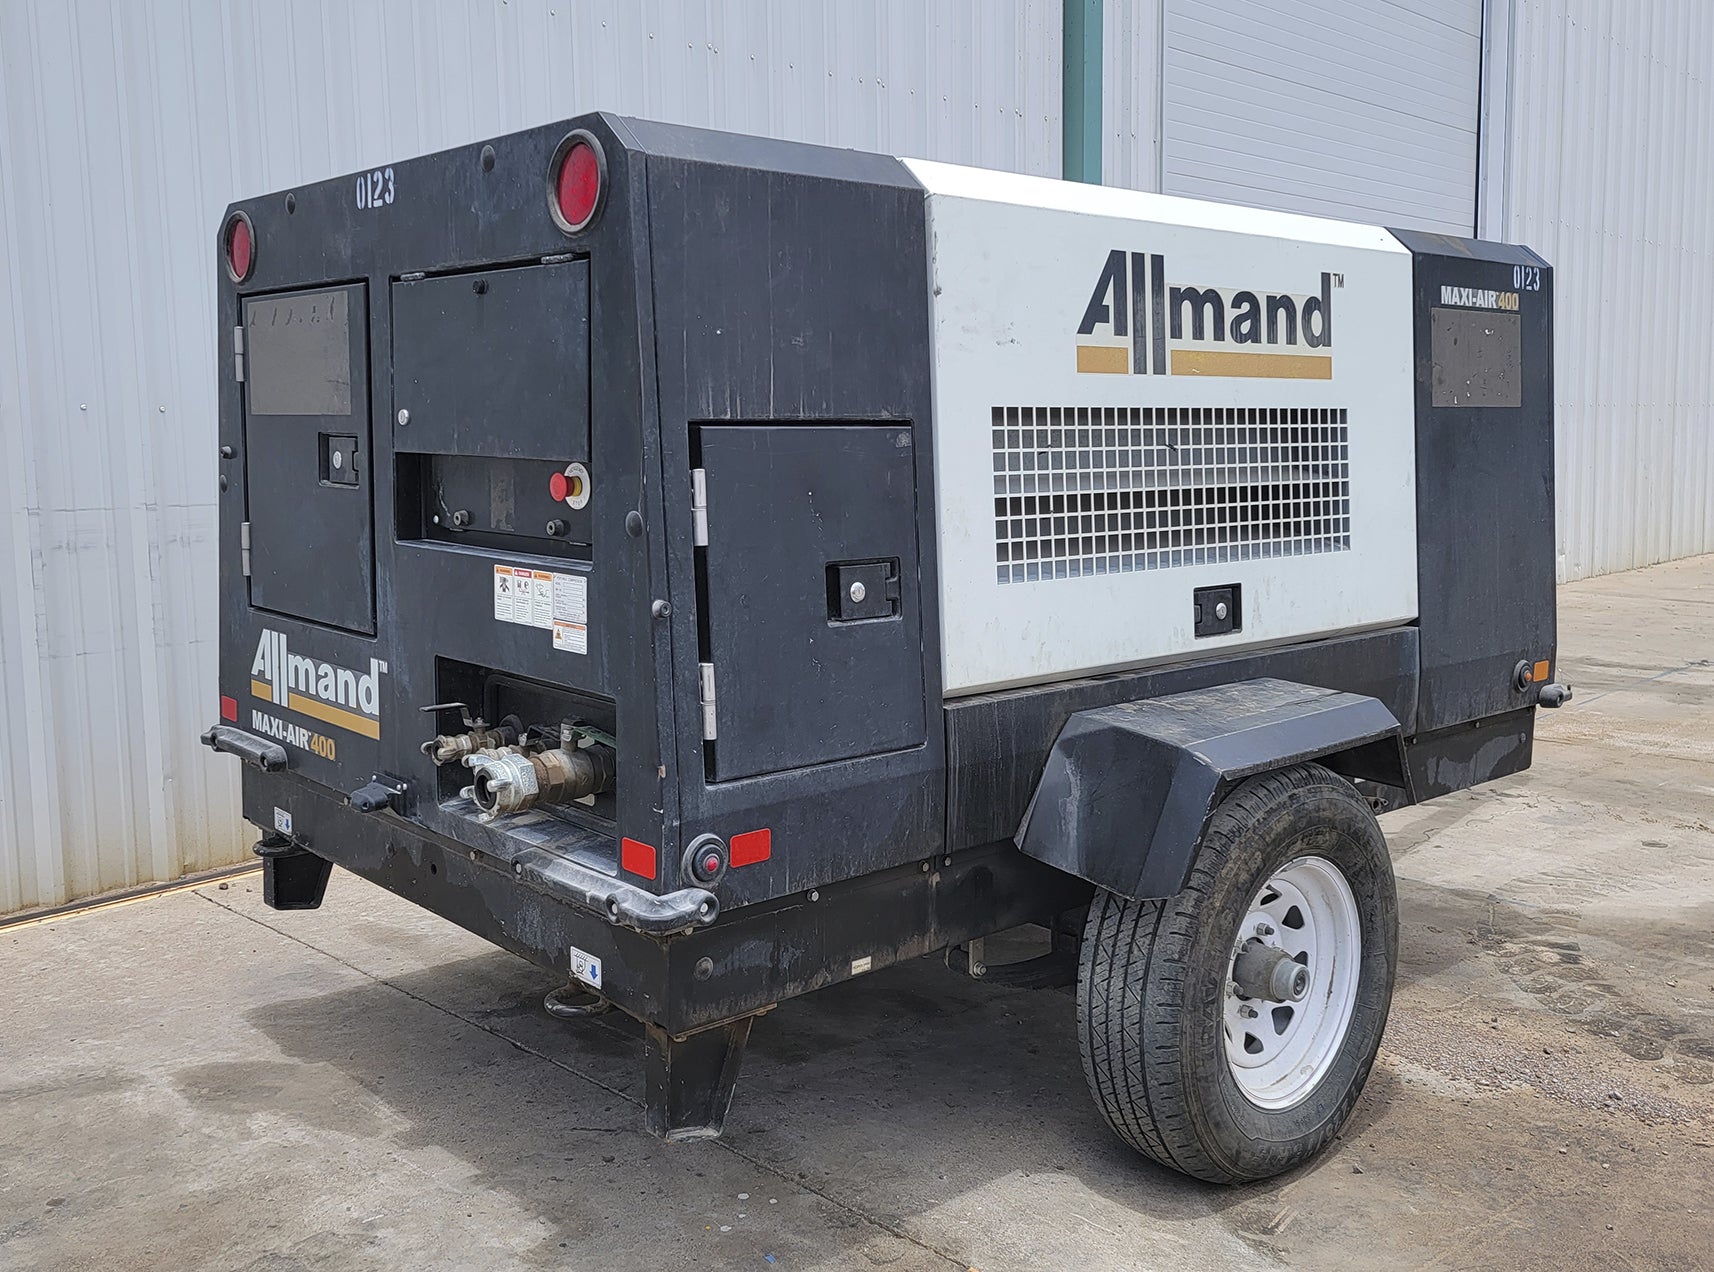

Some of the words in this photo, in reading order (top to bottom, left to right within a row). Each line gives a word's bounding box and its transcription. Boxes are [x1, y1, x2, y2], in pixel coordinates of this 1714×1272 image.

[356, 167, 395, 210] 0123
[1440, 285, 1497, 309] MAXI-AIR
[1497, 291, 1520, 311] 400
[1513, 265, 1541, 292] 0123
[1076, 249, 1332, 375] Allmand
[251, 628, 380, 715] Allmand
[252, 709, 309, 751] MAXI-AIR
[310, 733, 337, 761] 400
